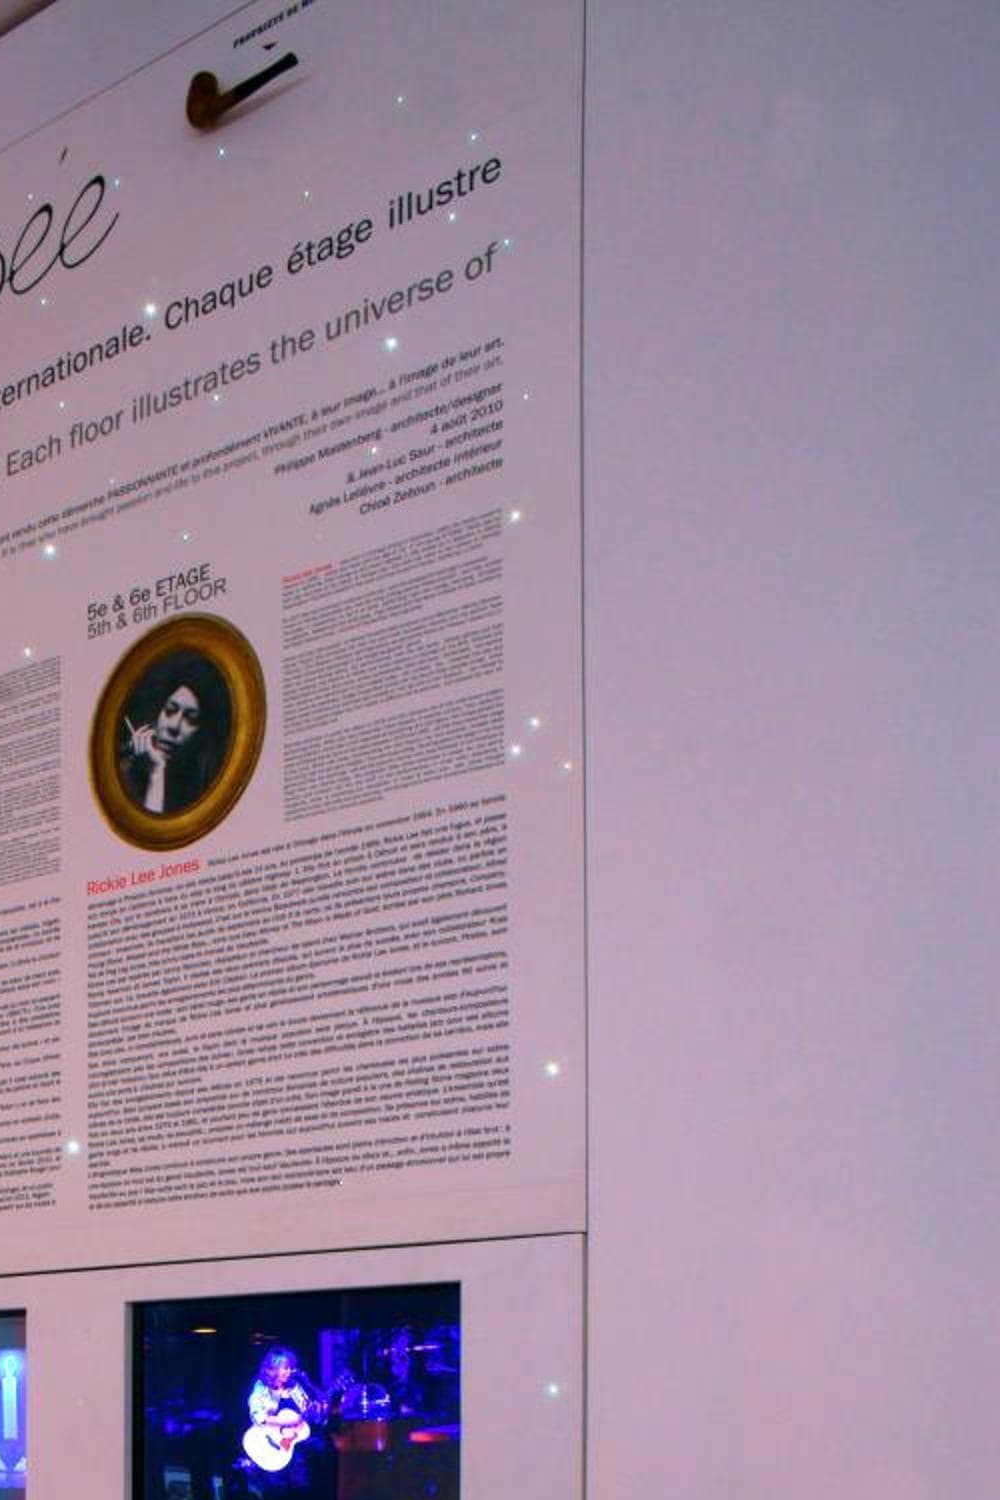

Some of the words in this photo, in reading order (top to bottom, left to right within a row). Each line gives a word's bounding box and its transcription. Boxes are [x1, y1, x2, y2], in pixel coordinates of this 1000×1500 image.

[165, 265, 273, 330] Chaque
[287, 219, 373, 275] étage
[389, 158, 501, 229] illustre
[7, 435, 61, 476] Each
[69, 410, 122, 449] floor
[133, 352, 261, 424] illustrates
[270, 329, 315, 364] the
[325, 270, 454, 341] universe
[465, 242, 497, 280] of
[471, 399, 503, 421] 2010
[445, 420, 503, 448] architecte
[395, 458, 451, 484] architecte
[445, 458, 504, 486] architecte
[88, 602, 107, 621] 5e
[112, 594, 125, 613] &
[130, 588, 151, 606] 6e
[156, 563, 211, 597] ETAGE
[88, 619, 111, 640] 5th
[116, 612, 128, 630] &
[132, 603, 157, 624] 6th
[163, 577, 227, 614] FLOOR
[87, 877, 128, 897] Rickie
[131, 869, 156, 886] Lee
[158, 858, 201, 882] Jones
